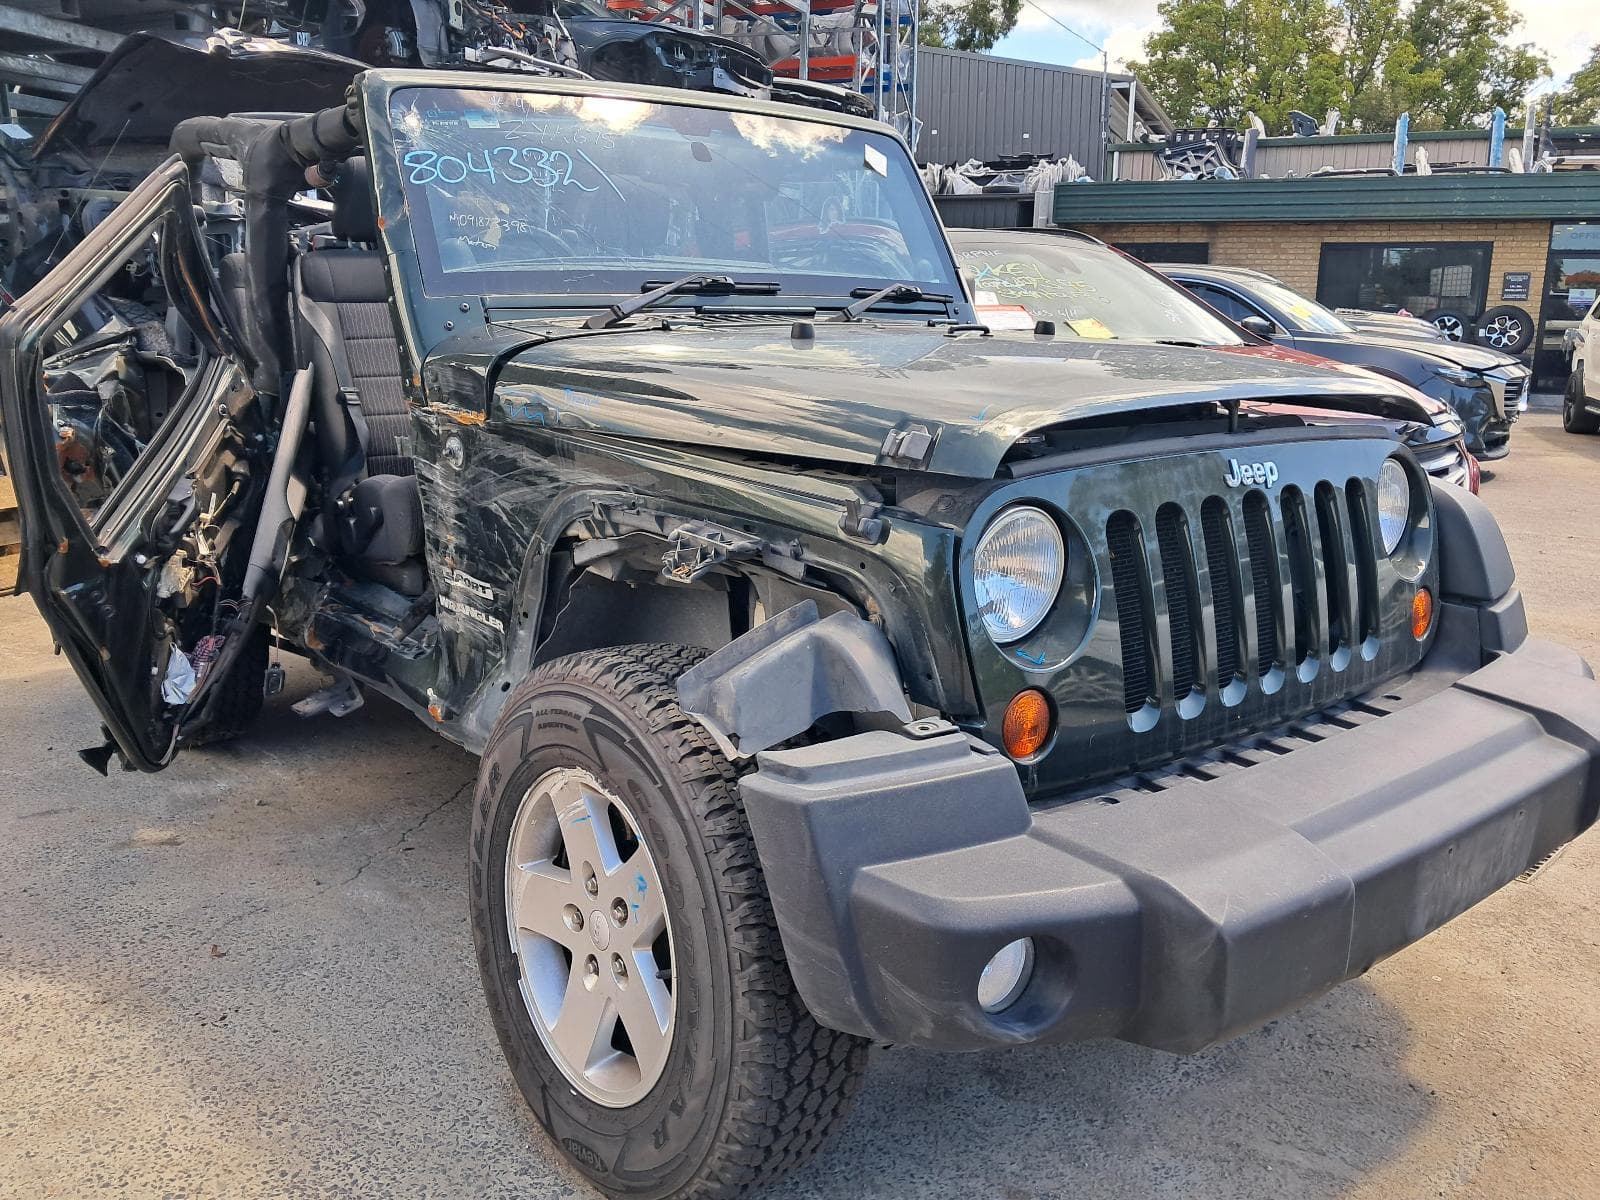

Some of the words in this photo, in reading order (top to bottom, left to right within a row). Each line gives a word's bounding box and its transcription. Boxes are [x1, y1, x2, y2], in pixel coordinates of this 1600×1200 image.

[1223, 457, 1279, 489] Jeep
[626, 778, 699, 1151] GOODYEAR
[567, 1138, 603, 1171] Kevlar
